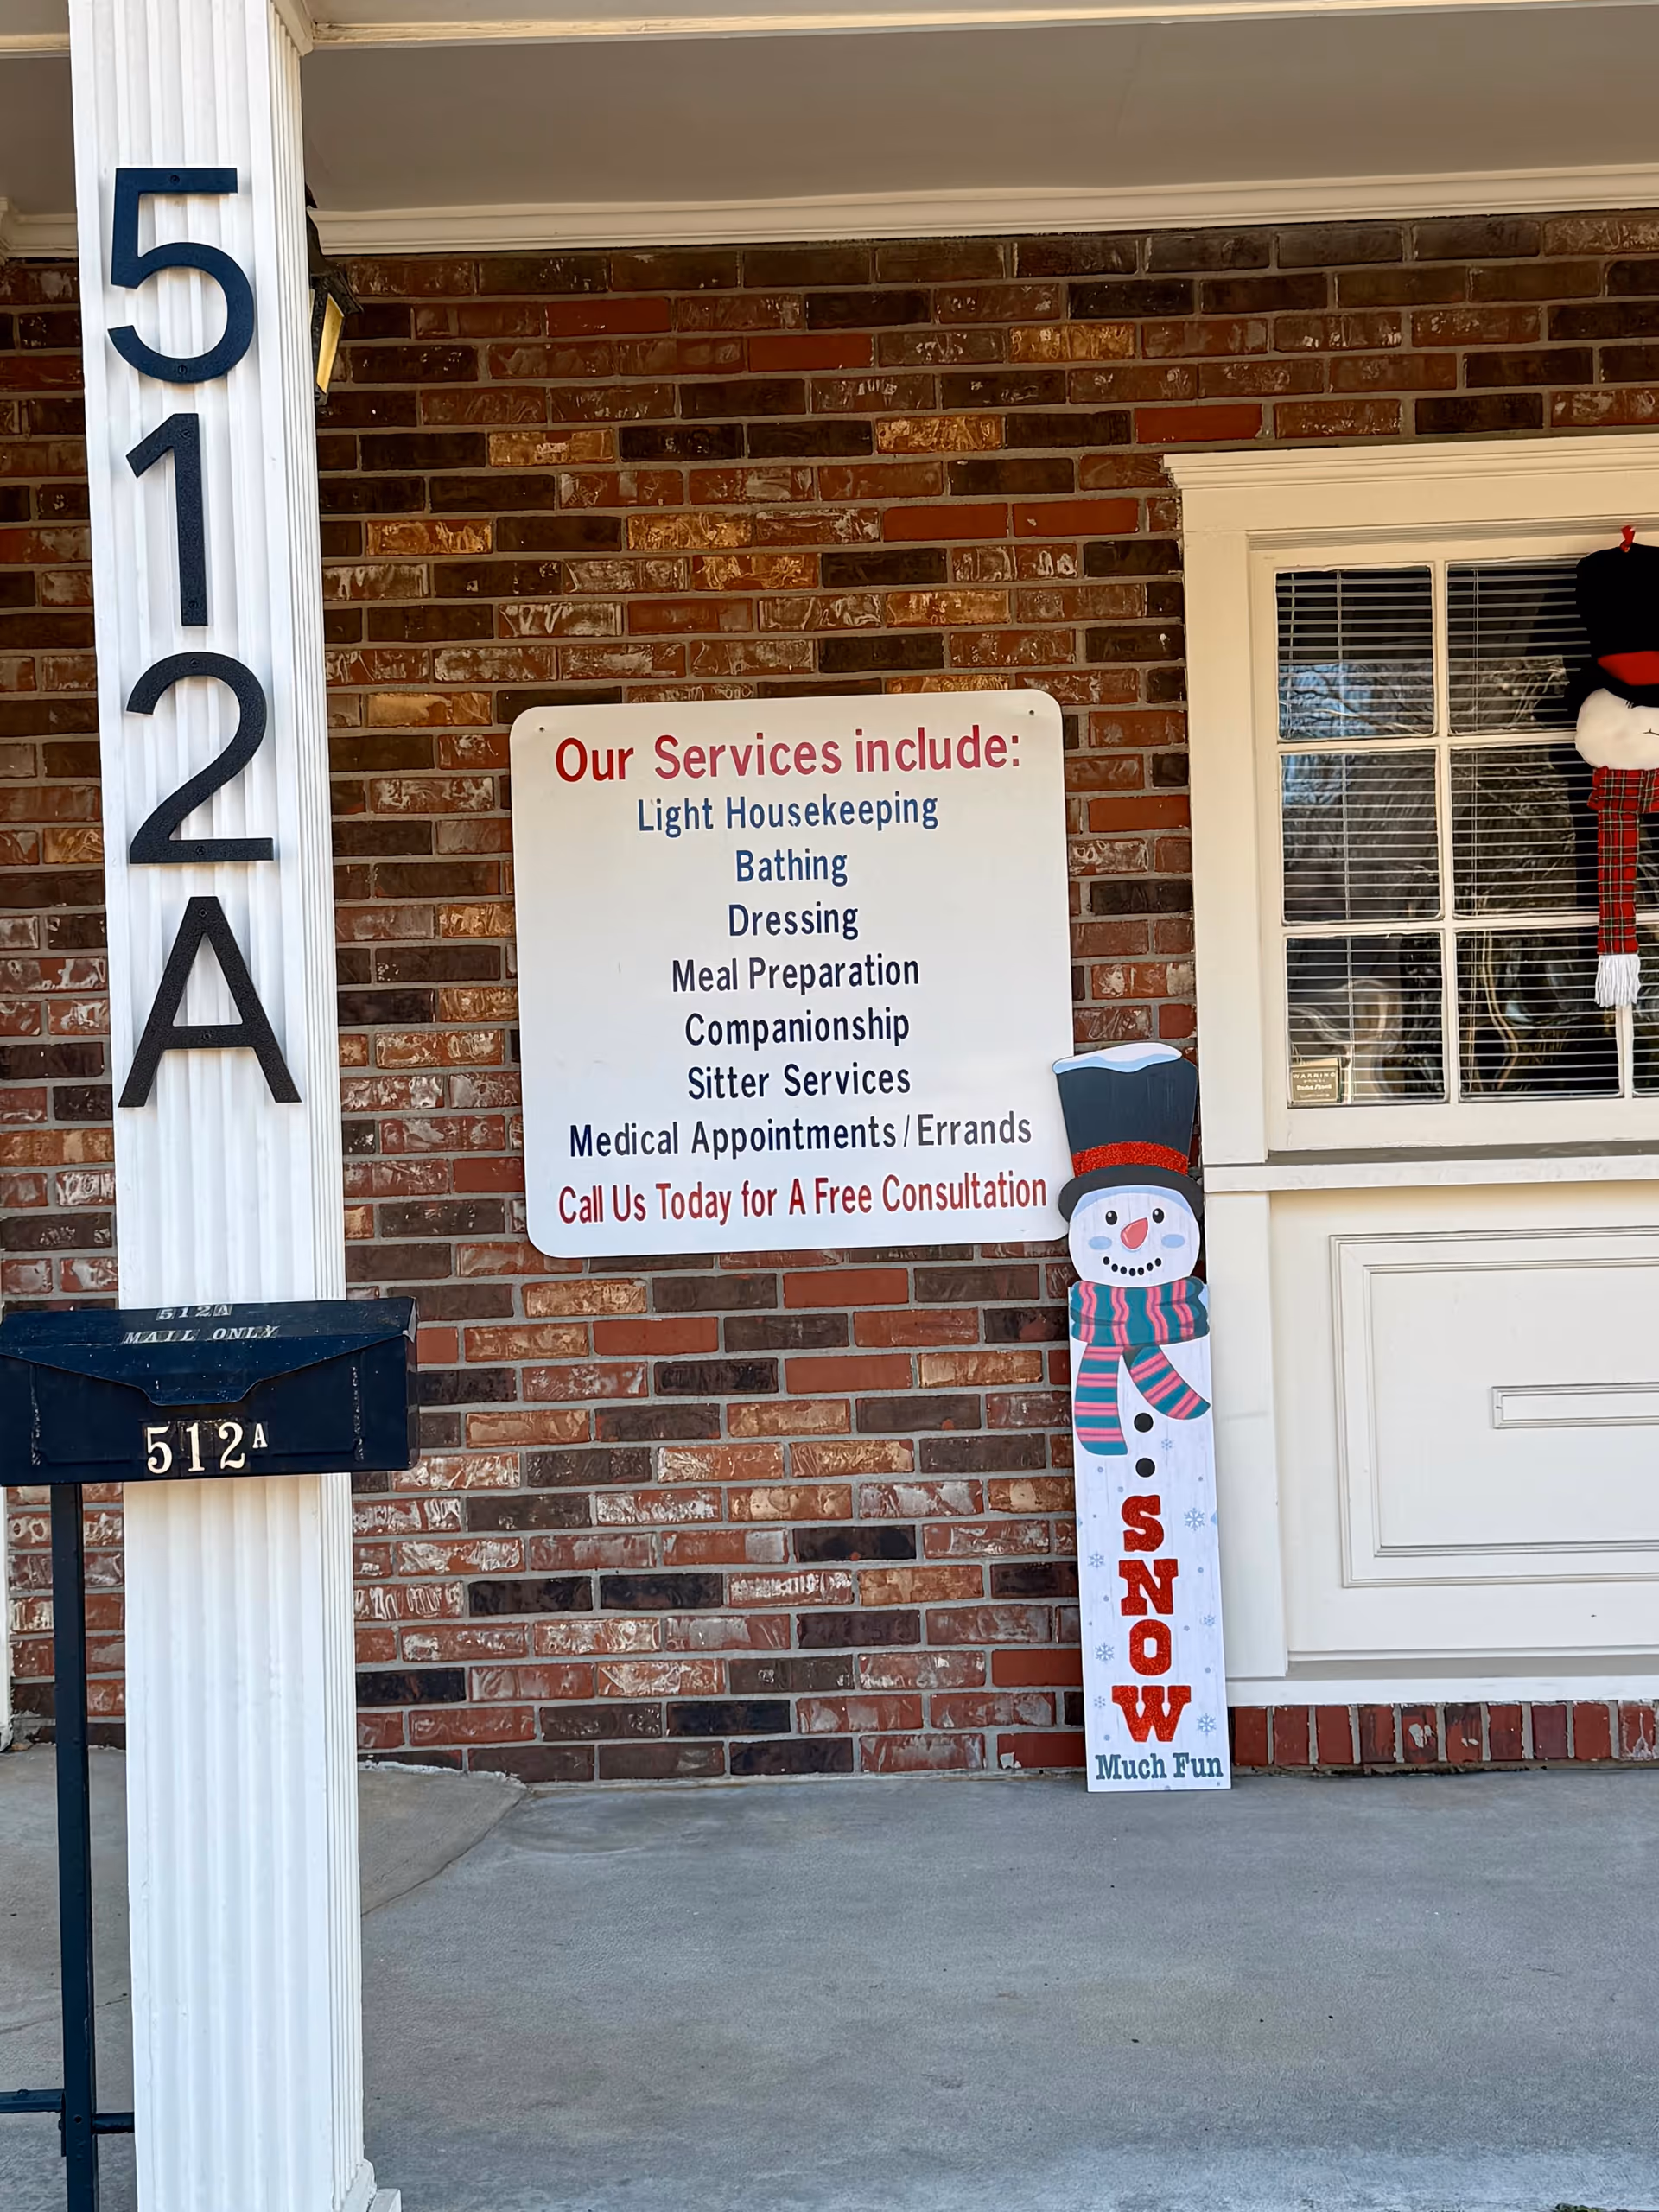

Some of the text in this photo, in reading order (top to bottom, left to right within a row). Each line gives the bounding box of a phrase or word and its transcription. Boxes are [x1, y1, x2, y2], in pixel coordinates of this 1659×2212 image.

[555, 724, 1020, 783] Our Services include:
[638, 791, 938, 839] Light Housekeeping
[735, 847, 848, 887] Bathing
[728, 900, 859, 941] Dressing
[672, 952, 919, 996] Meal Preparation
[685, 1006, 910, 1052] Companionship
[688, 1061, 911, 1101] Sitter Services
[569, 1121, 678, 1158] Medical
[558, 1170, 1047, 1226] Call Us Today for A Free Consultation
[156, 1304, 232, 1320] 512A
[125, 1325, 279, 1344] MAIL ONLY
[1111, 1494, 1192, 1743] SNOW
[1095, 1751, 1224, 1780] Much Fun
